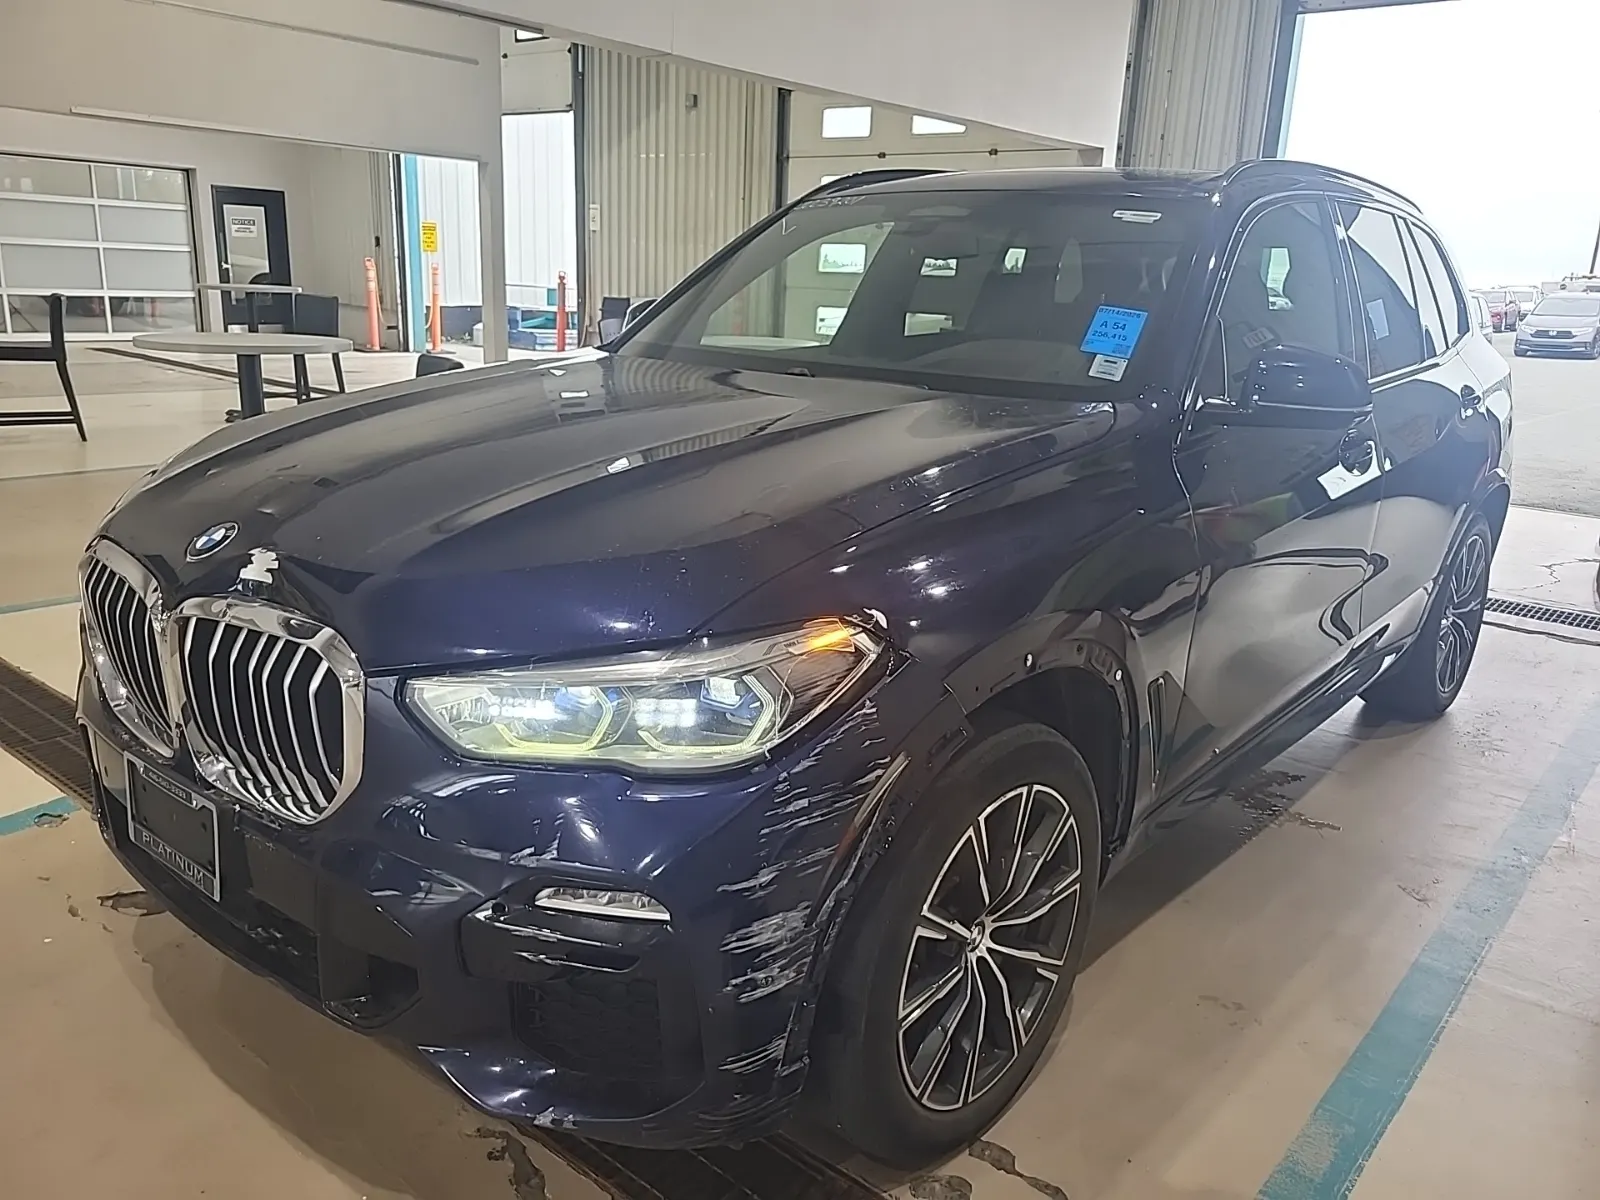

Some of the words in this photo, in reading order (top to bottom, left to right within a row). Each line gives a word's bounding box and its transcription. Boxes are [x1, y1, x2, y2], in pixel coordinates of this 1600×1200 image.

[1099, 320, 1108, 329] A
[1112, 321, 1127, 331] 54
[1092, 330, 1127, 341] 256,415
[142, 831, 204, 888] PLATINUM
